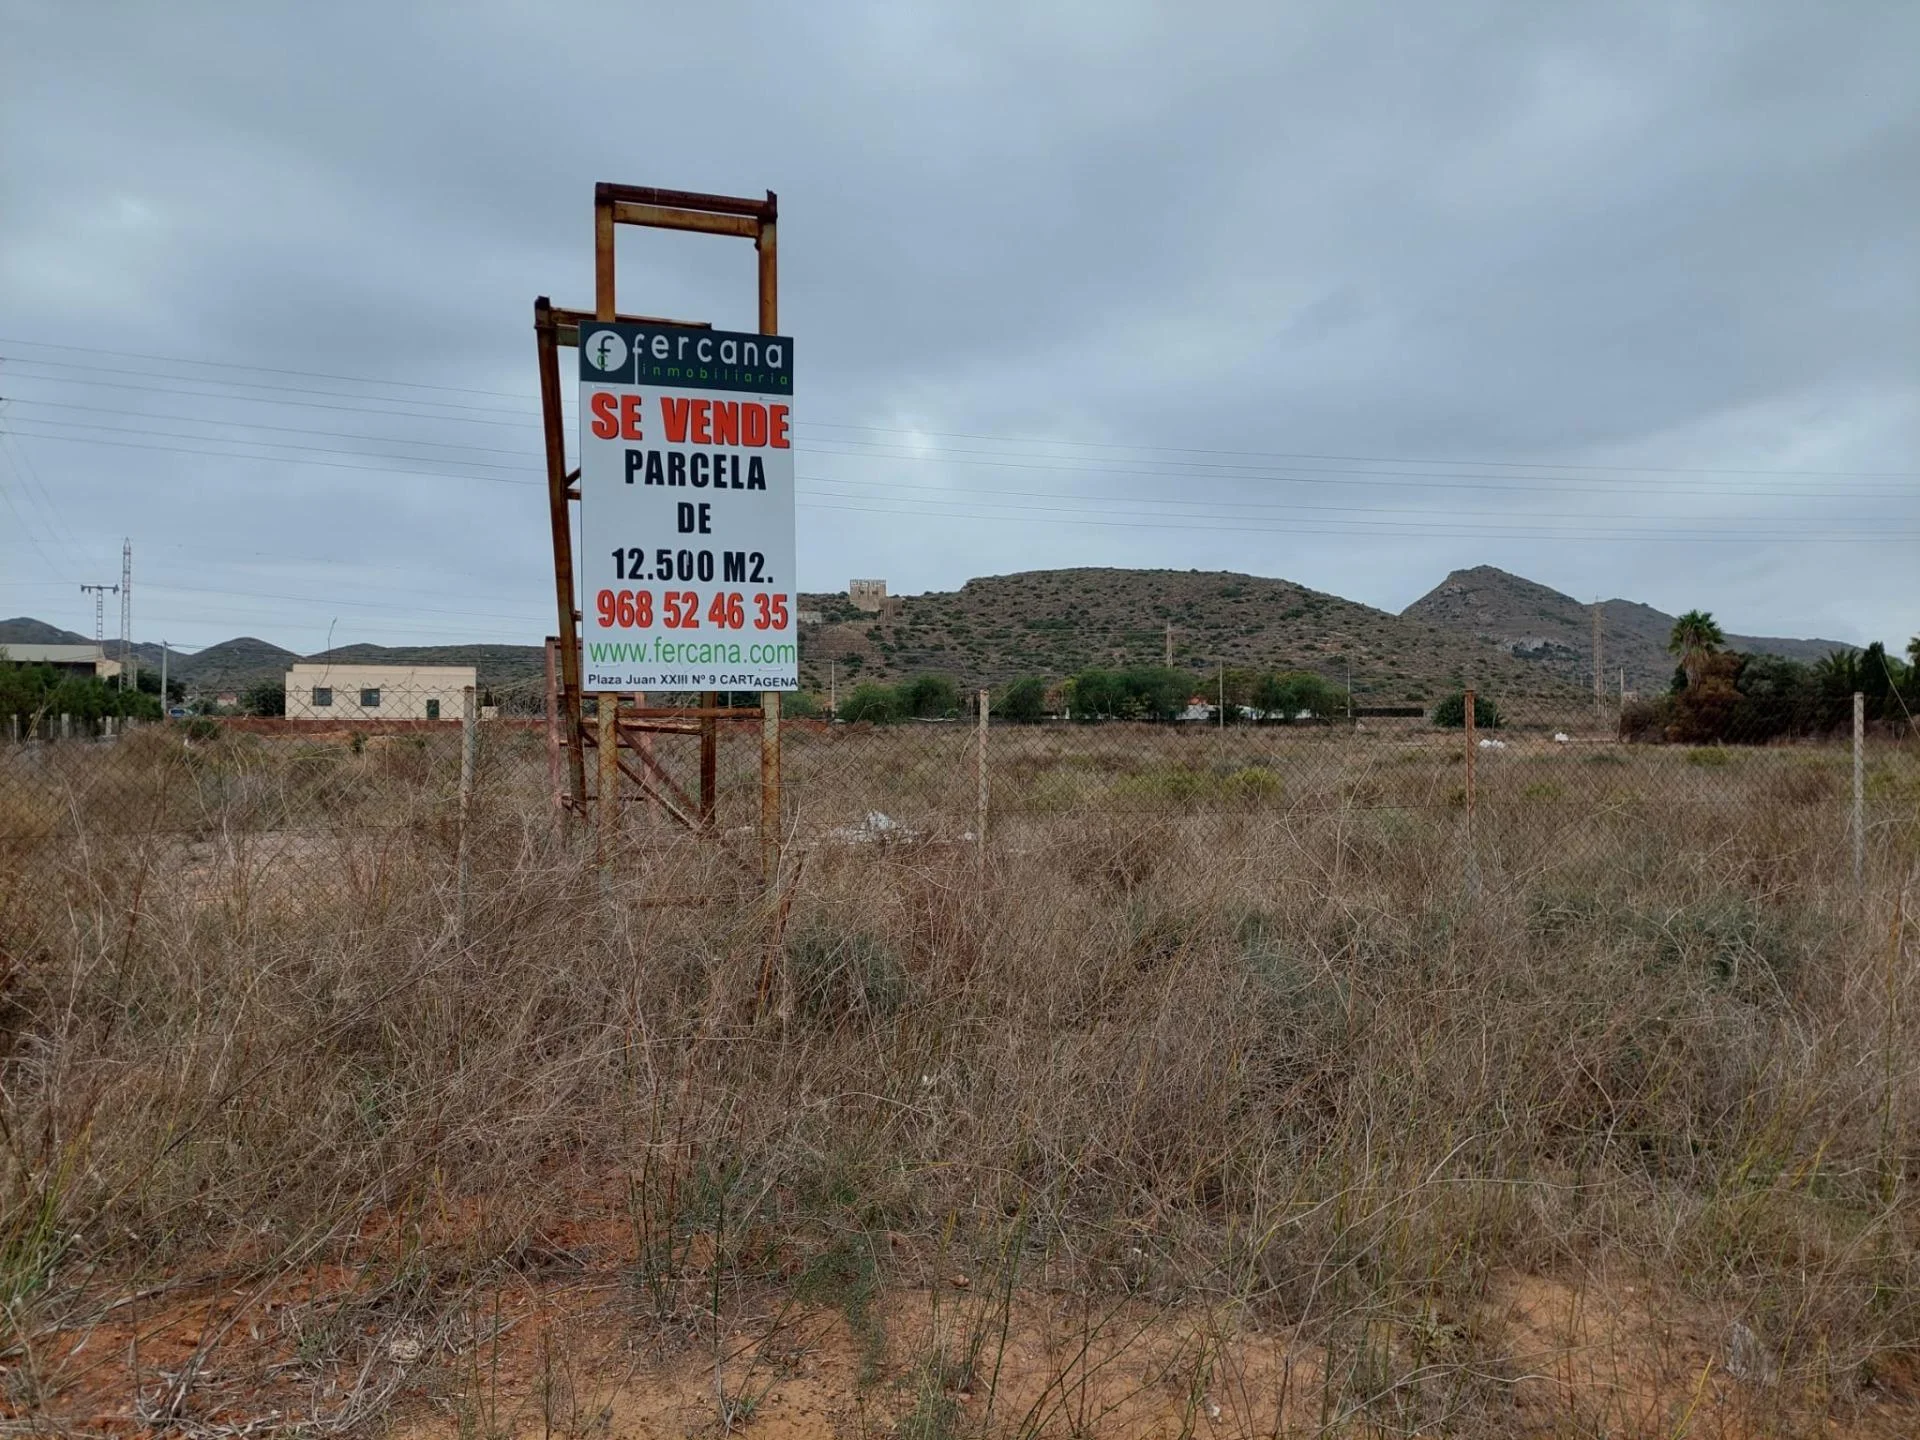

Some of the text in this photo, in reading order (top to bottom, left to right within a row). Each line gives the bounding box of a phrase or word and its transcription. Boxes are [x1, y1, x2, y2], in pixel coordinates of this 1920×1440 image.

[632, 333, 783, 385] fercana
[642, 363, 788, 385] inmobiliaria
[591, 392, 791, 449] SE VENDE
[625, 449, 767, 490] PARCELA
[677, 502, 712, 534] DE
[611, 548, 774, 583] 12.500 M2.
[597, 589, 789, 630] 968 52 46 35
[589, 636, 796, 664] www.fercana.com
[588, 674, 622, 685] Plaza
[626, 674, 656, 685] Juan
[660, 674, 688, 685] XXIII
[709, 674, 717, 685] 9
[720, 674, 798, 687] CARTAGENA
